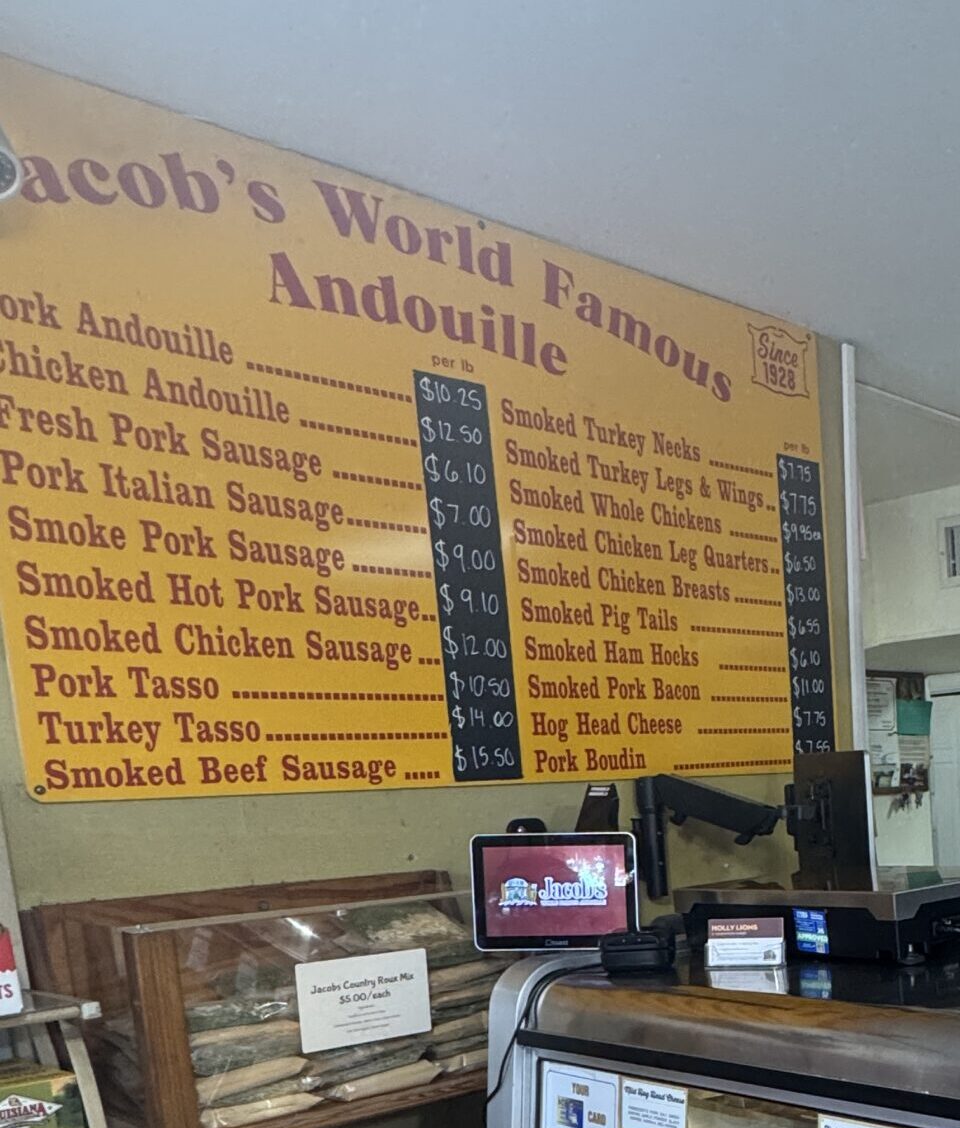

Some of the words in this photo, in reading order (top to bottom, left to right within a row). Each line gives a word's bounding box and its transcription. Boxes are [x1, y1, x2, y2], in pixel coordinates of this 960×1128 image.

[17, 151, 286, 225] acob's
[314, 180, 513, 287] World
[543, 259, 733, 402] Famous
[0, 291, 62, 330] ork
[77, 302, 234, 365] Andouille
[269, 251, 568, 377] Andouille
[757, 332, 799, 369] Since
[420, 376, 482, 411] $10.25
[762, 361, 796, 392] 1928
[144, 367, 290, 424] Andouille
[0, 395, 97, 443] Fresh
[110, 411, 190, 456] Pork
[201, 429, 322, 482] Sausage
[421, 417, 482, 445] $12.50
[501, 399, 577, 438] Smoked
[583, 414, 646, 456] Turkey
[652, 431, 701, 463] Necks
[424, 453, 487, 485] $6.10
[505, 438, 581, 478] Smoked
[586, 454, 649, 495] Turkey
[655, 467, 693, 500] Legs
[699, 479, 711, 499] &
[717, 479, 764, 512] Wings
[1, 449, 88, 493] Pork
[99, 463, 215, 510] Italian
[226, 481, 344, 532] Sausage
[509, 479, 585, 515] Smoked
[590, 491, 645, 523] Whole
[651, 497, 722, 535] Chickens
[429, 497, 491, 530] $7.00
[8, 505, 126, 550] Smoke
[140, 519, 217, 559] Pork
[229, 530, 345, 578] Sausage
[434, 540, 496, 572] $9.00
[512, 519, 588, 553] Smoked
[594, 527, 663, 561] Chicken
[668, 536, 698, 571] Leg
[704, 543, 769, 575] Quarters
[16, 560, 155, 603] Smoked
[167, 573, 225, 608] Hot
[235, 579, 303, 614] Pork
[314, 587, 420, 628] Sausage
[517, 558, 591, 590] Smoked
[599, 566, 666, 598] Chicken
[673, 572, 730, 602] Breasts
[440, 583, 499, 616] $9.10
[521, 597, 593, 627] Smoked
[601, 602, 630, 634] Pig
[637, 604, 678, 632] Tails
[24, 614, 162, 655] Smoked
[174, 622, 294, 659] Chicken
[305, 630, 412, 671] Sausage
[442, 626, 508, 660] $12.00
[524, 635, 597, 664] Smoked
[604, 639, 644, 666] Ham
[650, 640, 699, 667] Hocks
[31, 663, 117, 699] Pork
[129, 666, 219, 700] Tasso
[449, 672, 510, 699] $10.50
[528, 673, 599, 700] Smoked
[607, 675, 647, 700] Pork
[652, 676, 700, 701] Bacon
[38, 712, 161, 752] Turkey
[174, 712, 261, 743] Tasso
[452, 705, 514, 730] $14.00
[531, 711, 568, 742] Hog
[576, 711, 621, 736] Head
[627, 710, 682, 735] Cheese
[45, 757, 186, 791] Smoked
[199, 755, 268, 785] Beef
[282, 754, 396, 786] Sausage
[455, 744, 515, 772] $15.50
[535, 749, 578, 774] Pork
[585, 748, 646, 771] Boudin
[310, 983, 341, 995] Jacobs
[343, 978, 376, 991] Country
[399, 973, 415, 982] Mix
[571, 1083, 590, 1097] YOUR
[587, 1111, 607, 1126] CARD
